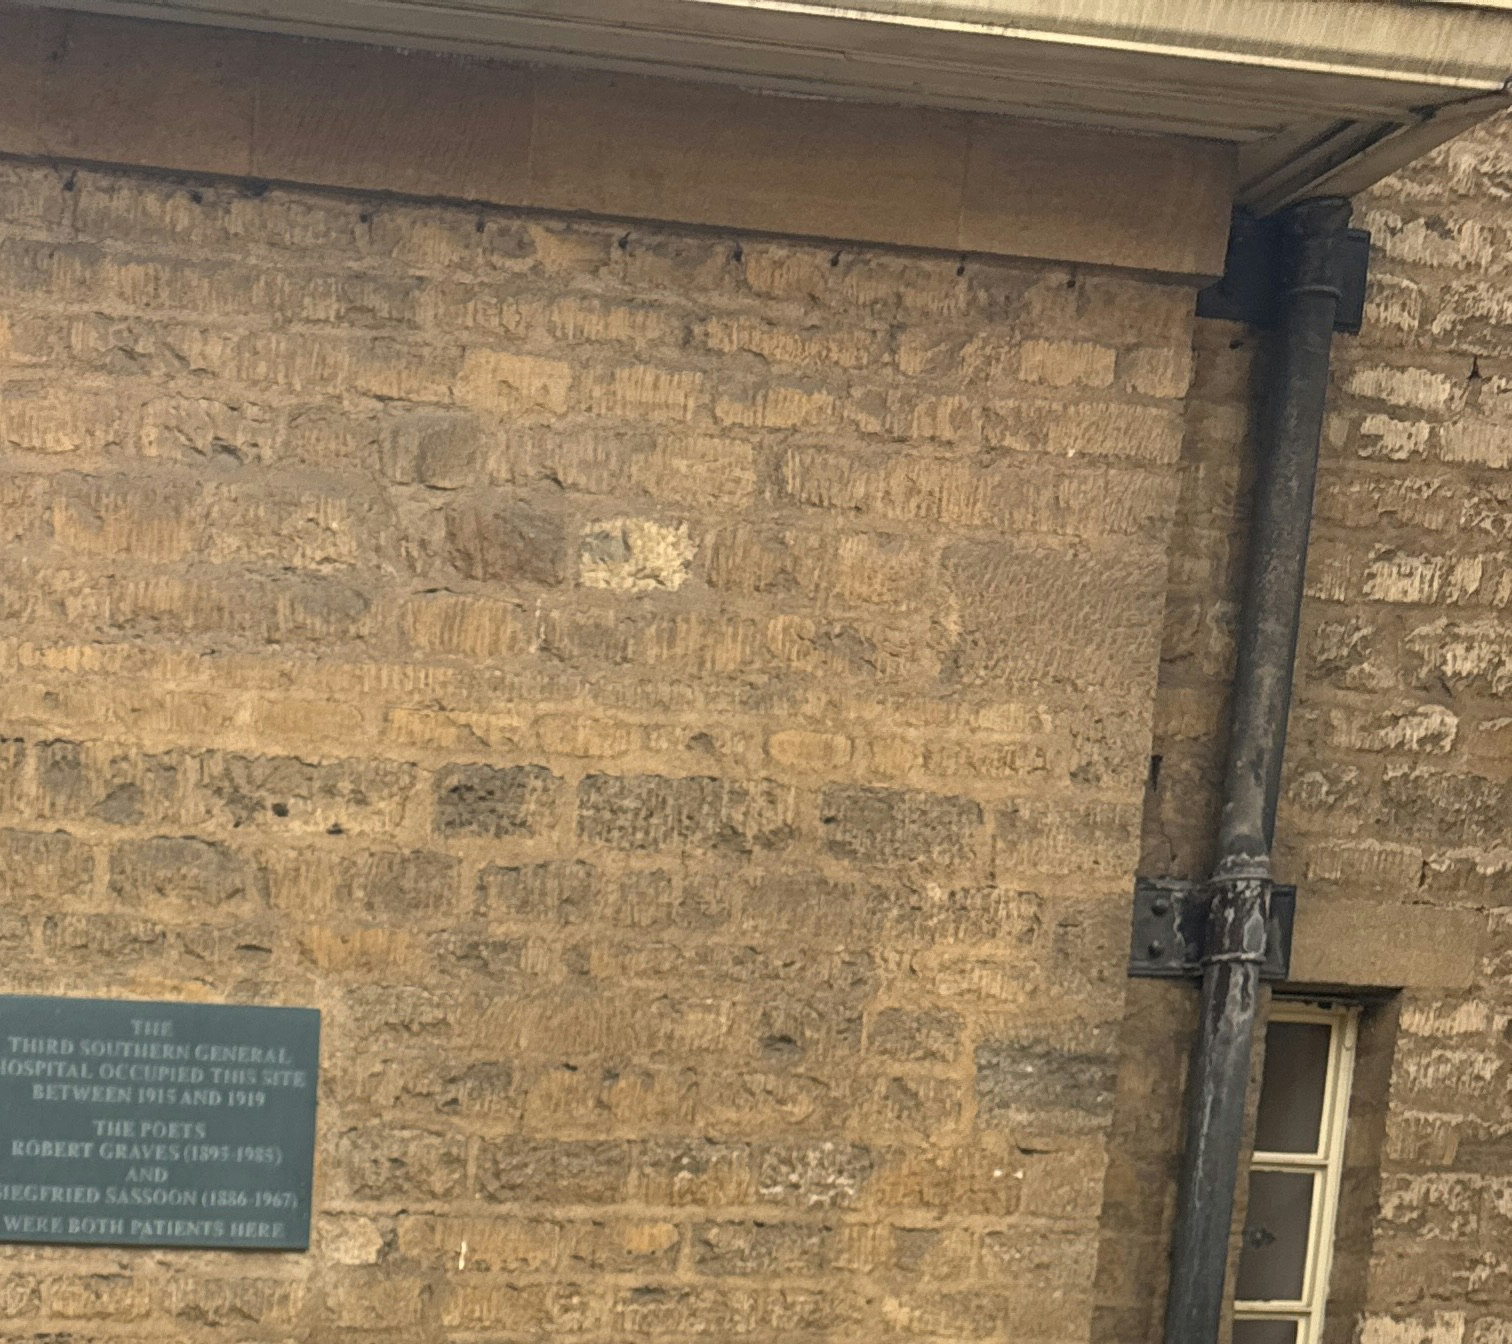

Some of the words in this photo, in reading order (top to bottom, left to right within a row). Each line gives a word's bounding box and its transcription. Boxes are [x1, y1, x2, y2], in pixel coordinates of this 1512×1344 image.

[131, 1019, 173, 1037] THE
[8, 1037, 74, 1055] THIRD
[79, 1039, 190, 1060] SOUTHERN
[194, 1044, 293, 1064] GENERAL
[99, 1063, 203, 1083] OCCUPIED
[211, 1068, 257, 1085] THIS
[263, 1069, 306, 1088] SITE
[33, 1084, 132, 1103] BETWEEN
[138, 1087, 176, 1105] 1915
[180, 1089, 222, 1106] AND
[228, 1090, 265, 1107] 1919
[93, 1120, 135, 1138] THE
[140, 1122, 207, 1139] POETS
[12, 1141, 94, 1158] ROBERT
[99, 1142, 180, 1160] GRAVES
[125, 1167, 168, 1183] AND
[105, 1187, 196, 1206] SASSOON
[4, 1216, 63, 1233] WERE
[68, 1217, 124, 1234] BOTH
[130, 1218, 224, 1237] PATIENTS
[230, 1222, 286, 1238] HERE
